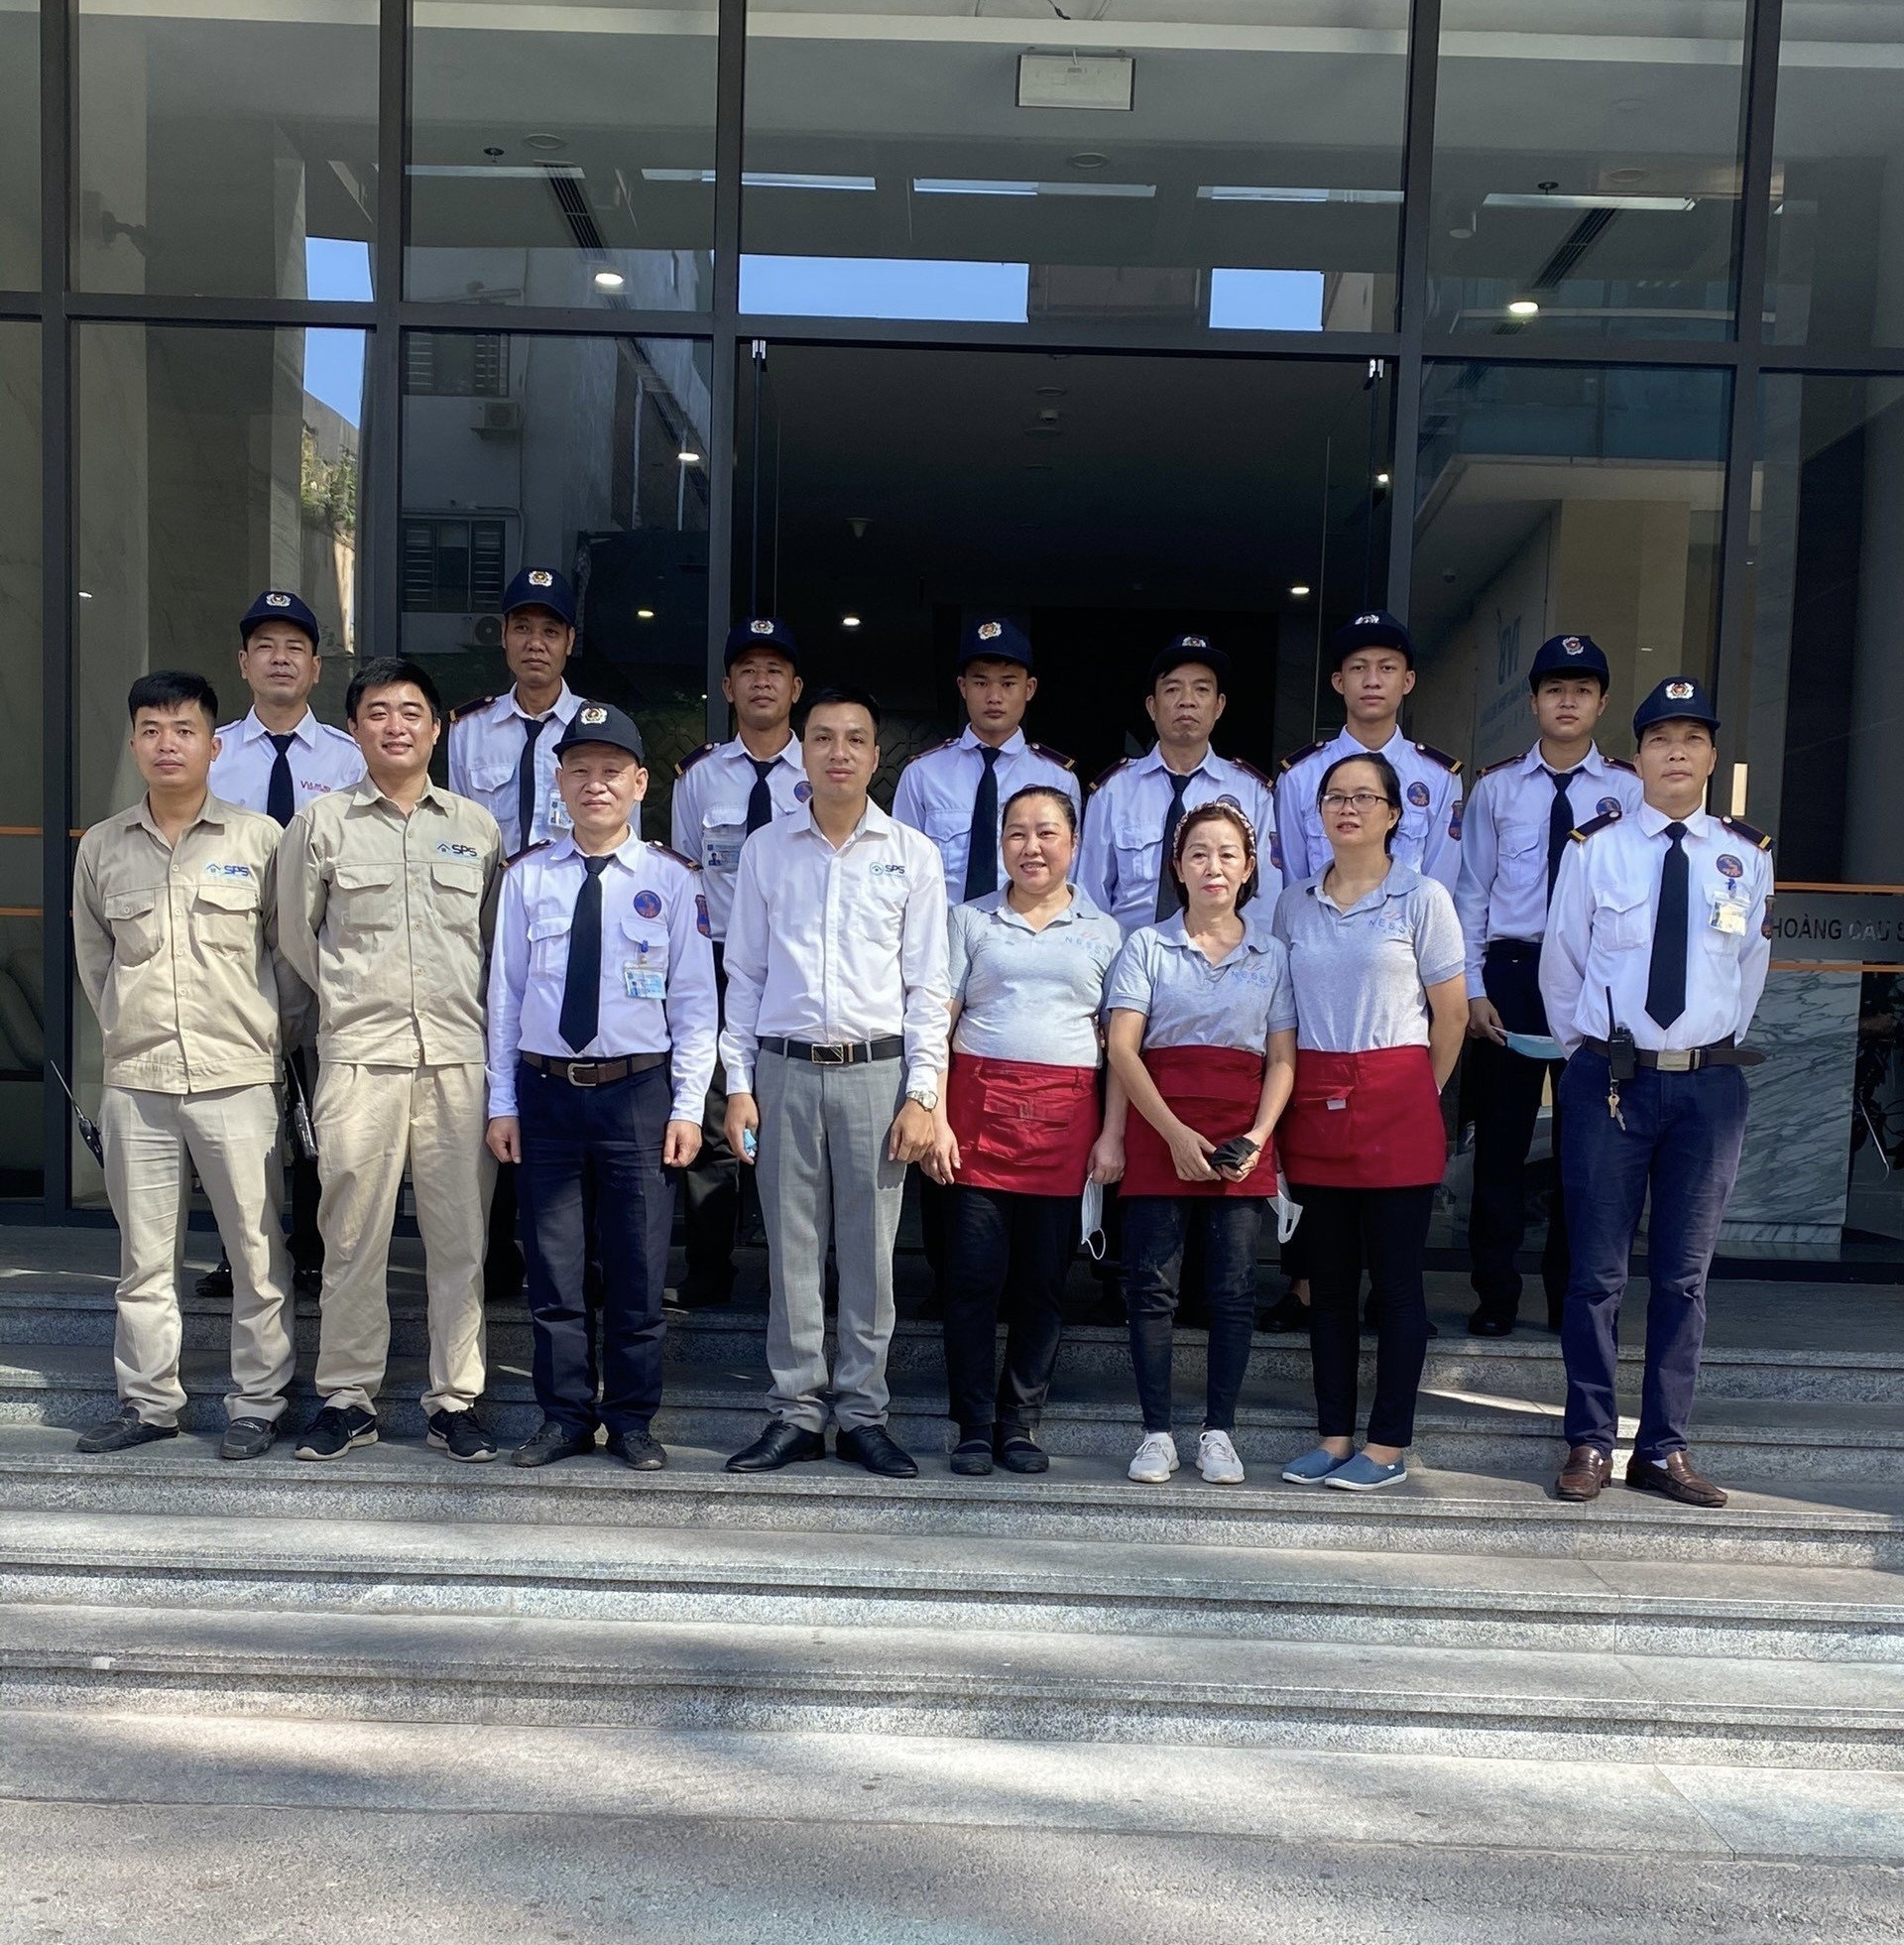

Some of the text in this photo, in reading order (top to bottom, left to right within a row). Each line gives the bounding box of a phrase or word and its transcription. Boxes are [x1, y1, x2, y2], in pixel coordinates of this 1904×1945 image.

[451, 844, 478, 857] SPS
[223, 865, 249, 877] SPS
[885, 864, 905, 874] SPS
